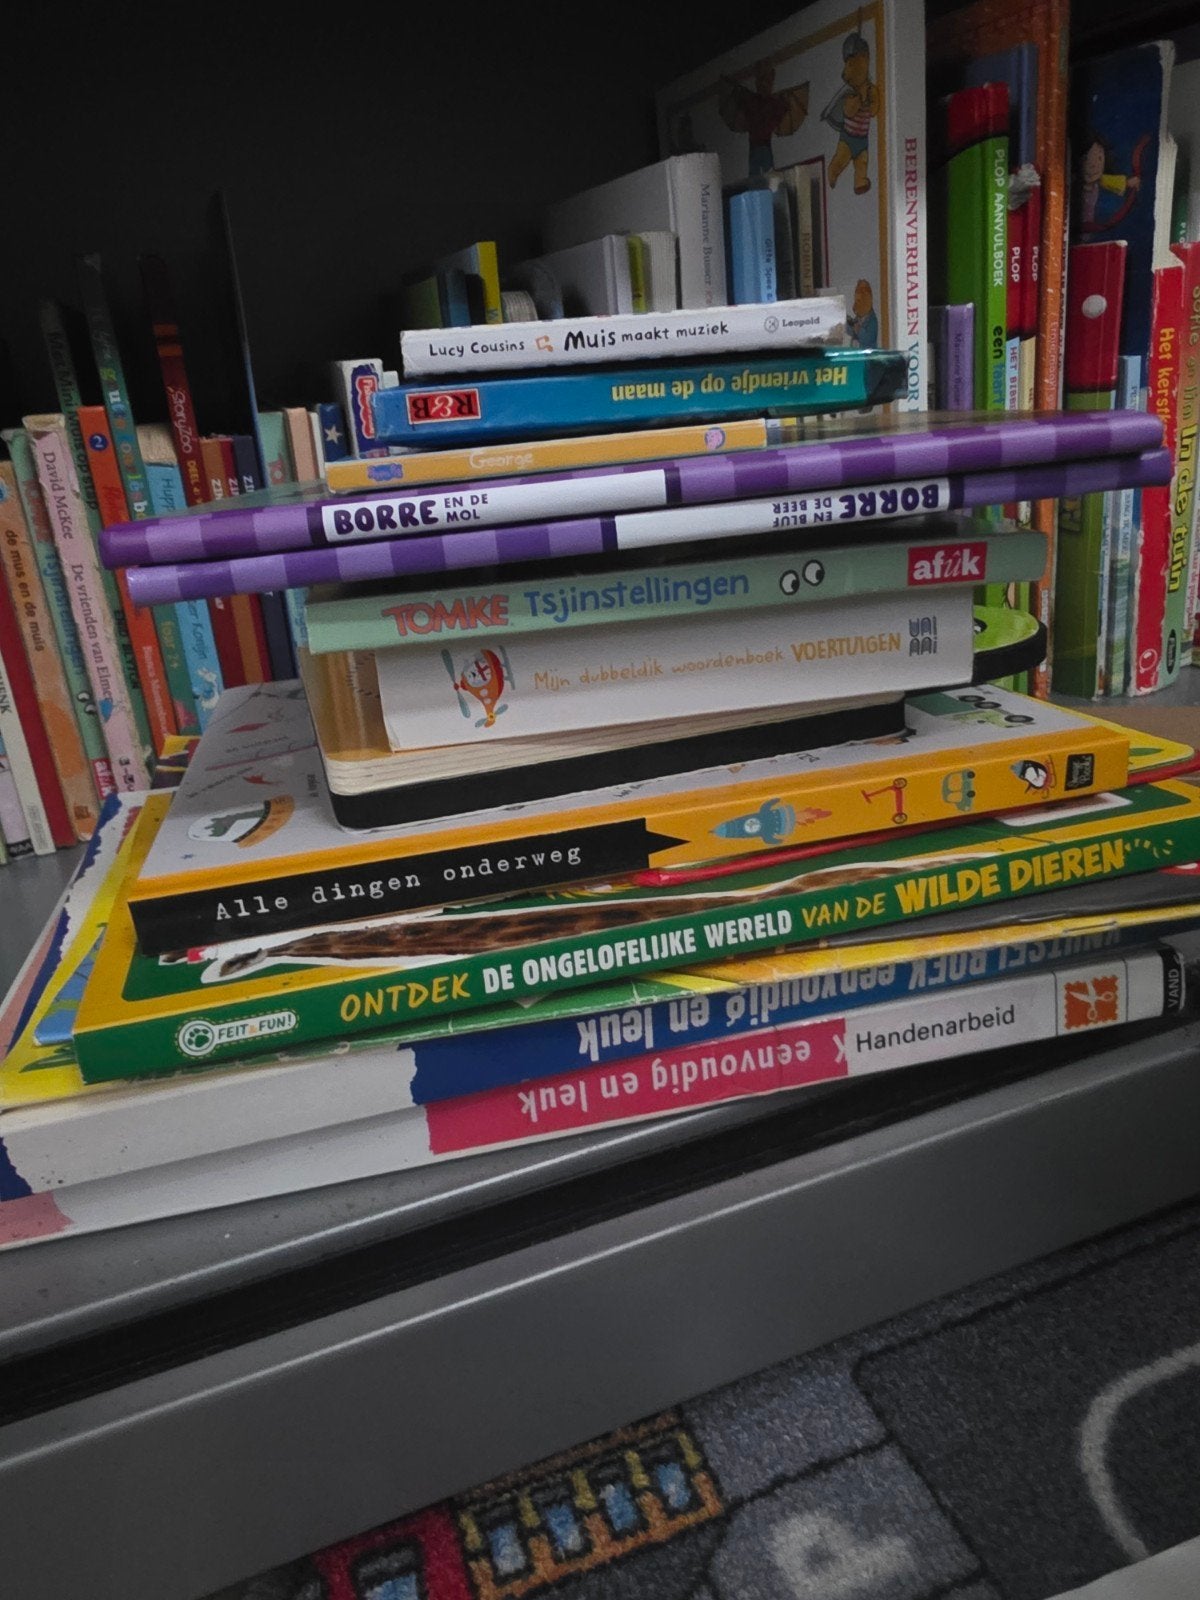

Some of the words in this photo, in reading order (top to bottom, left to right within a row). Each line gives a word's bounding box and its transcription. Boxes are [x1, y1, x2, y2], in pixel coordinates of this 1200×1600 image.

[995, 148, 1006, 187] PLOP
[700, 183, 712, 243] Marianne
[904, 137, 919, 336] BERENVERHALEN
[993, 192, 1006, 287] AANVULBOEK
[702, 246, 713, 286] Busser
[1011, 246, 1020, 283] PLOP
[1031, 246, 1040, 282] PLOP
[429, 343, 464, 357] Lucy
[471, 340, 525, 354] Cousins
[564, 330, 616, 351] Muis
[621, 327, 670, 342] maakt
[676, 321, 729, 338] muziek
[782, 316, 821, 328] Leopold
[993, 325, 1003, 359] een
[1158, 327, 1175, 360] Het
[671, 379, 695, 399] de
[700, 373, 725, 393] op
[731, 371, 809, 394] vriendje
[815, 365, 848, 386] Het
[907, 342, 919, 402] VOOR
[611, 382, 665, 401] maan
[469, 450, 533, 470] George
[1179, 424, 1198, 462] In
[43, 451, 63, 491] David
[772, 499, 807, 514] BEER
[814, 497, 832, 510] DE
[839, 483, 939, 519] BORRE
[1175, 467, 1195, 516] de
[54, 494, 75, 541] McKee
[333, 500, 438, 535] BORRE
[444, 497, 463, 509] EN
[470, 493, 489, 506] DE
[446, 508, 481, 523] MOL
[772, 512, 807, 528] BLUF
[815, 511, 833, 523] EN
[5, 530, 19, 547] de
[9, 549, 26, 578] mus
[71, 563, 86, 582] De
[1168, 524, 1189, 594] tuin
[19, 581, 32, 599] en
[381, 595, 510, 636] TOMKE
[524, 574, 749, 623] Tsjinstellingen
[913, 549, 980, 582] afûk
[24, 601, 38, 618] de
[76, 584, 103, 640] vrienden
[28, 621, 45, 653] muis
[90, 641, 104, 663] van
[534, 669, 570, 691] Mijn
[579, 656, 664, 684] dubbeldik
[672, 650, 784, 674] woordenboek
[790, 632, 901, 663] VOERTUIGEN
[216, 895, 289, 921] Alle
[312, 871, 421, 905] dingen
[443, 845, 582, 881] onderweg
[339, 972, 472, 1023] ONTDEK
[482, 966, 515, 995] DE
[522, 928, 696, 986] ONGELOFELIJKE
[703, 909, 793, 947] WERELD
[802, 900, 849, 929] VAN
[856, 892, 886, 916] DE
[895, 865, 1001, 915] WILDE
[1009, 838, 1127, 892] DIEREN
[725, 961, 896, 1027] eenvoudig
[669, 998, 710, 1033] en
[855, 1004, 1016, 1052] Handenarbeid
[576, 1007, 655, 1062] leuk
[652, 1040, 811, 1095] eenvoudig
[518, 1080, 588, 1123] leuk
[600, 1073, 639, 1099] en
